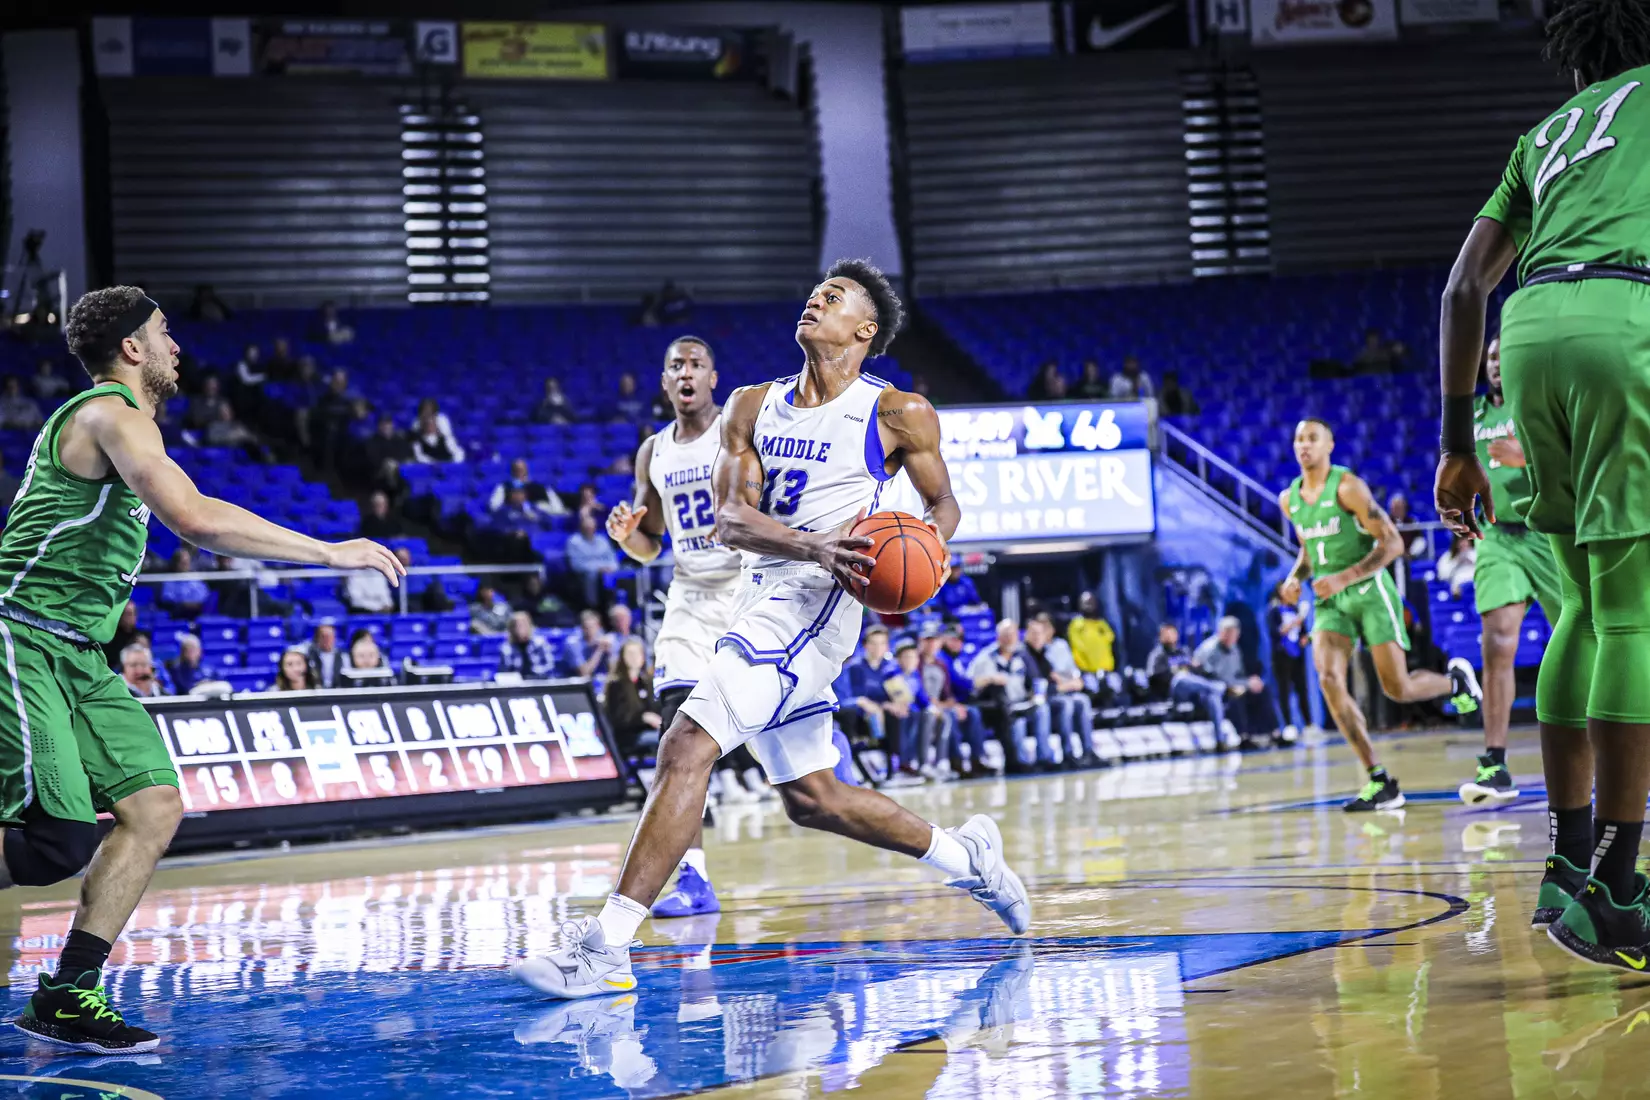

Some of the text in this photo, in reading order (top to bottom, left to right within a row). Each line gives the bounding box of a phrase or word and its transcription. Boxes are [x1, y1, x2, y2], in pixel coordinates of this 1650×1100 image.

[426, 28, 451, 57] G
[762, 435, 831, 463] MIDDLE
[1070, 409, 1122, 451] 46
[664, 464, 711, 488] MIDDLE
[760, 467, 809, 516] 13
[998, 457, 1145, 507] RIVER
[673, 488, 716, 530] 22
[1316, 541, 1328, 565] 1
[196, 744, 550, 804] 15 8 5 2 19 9
